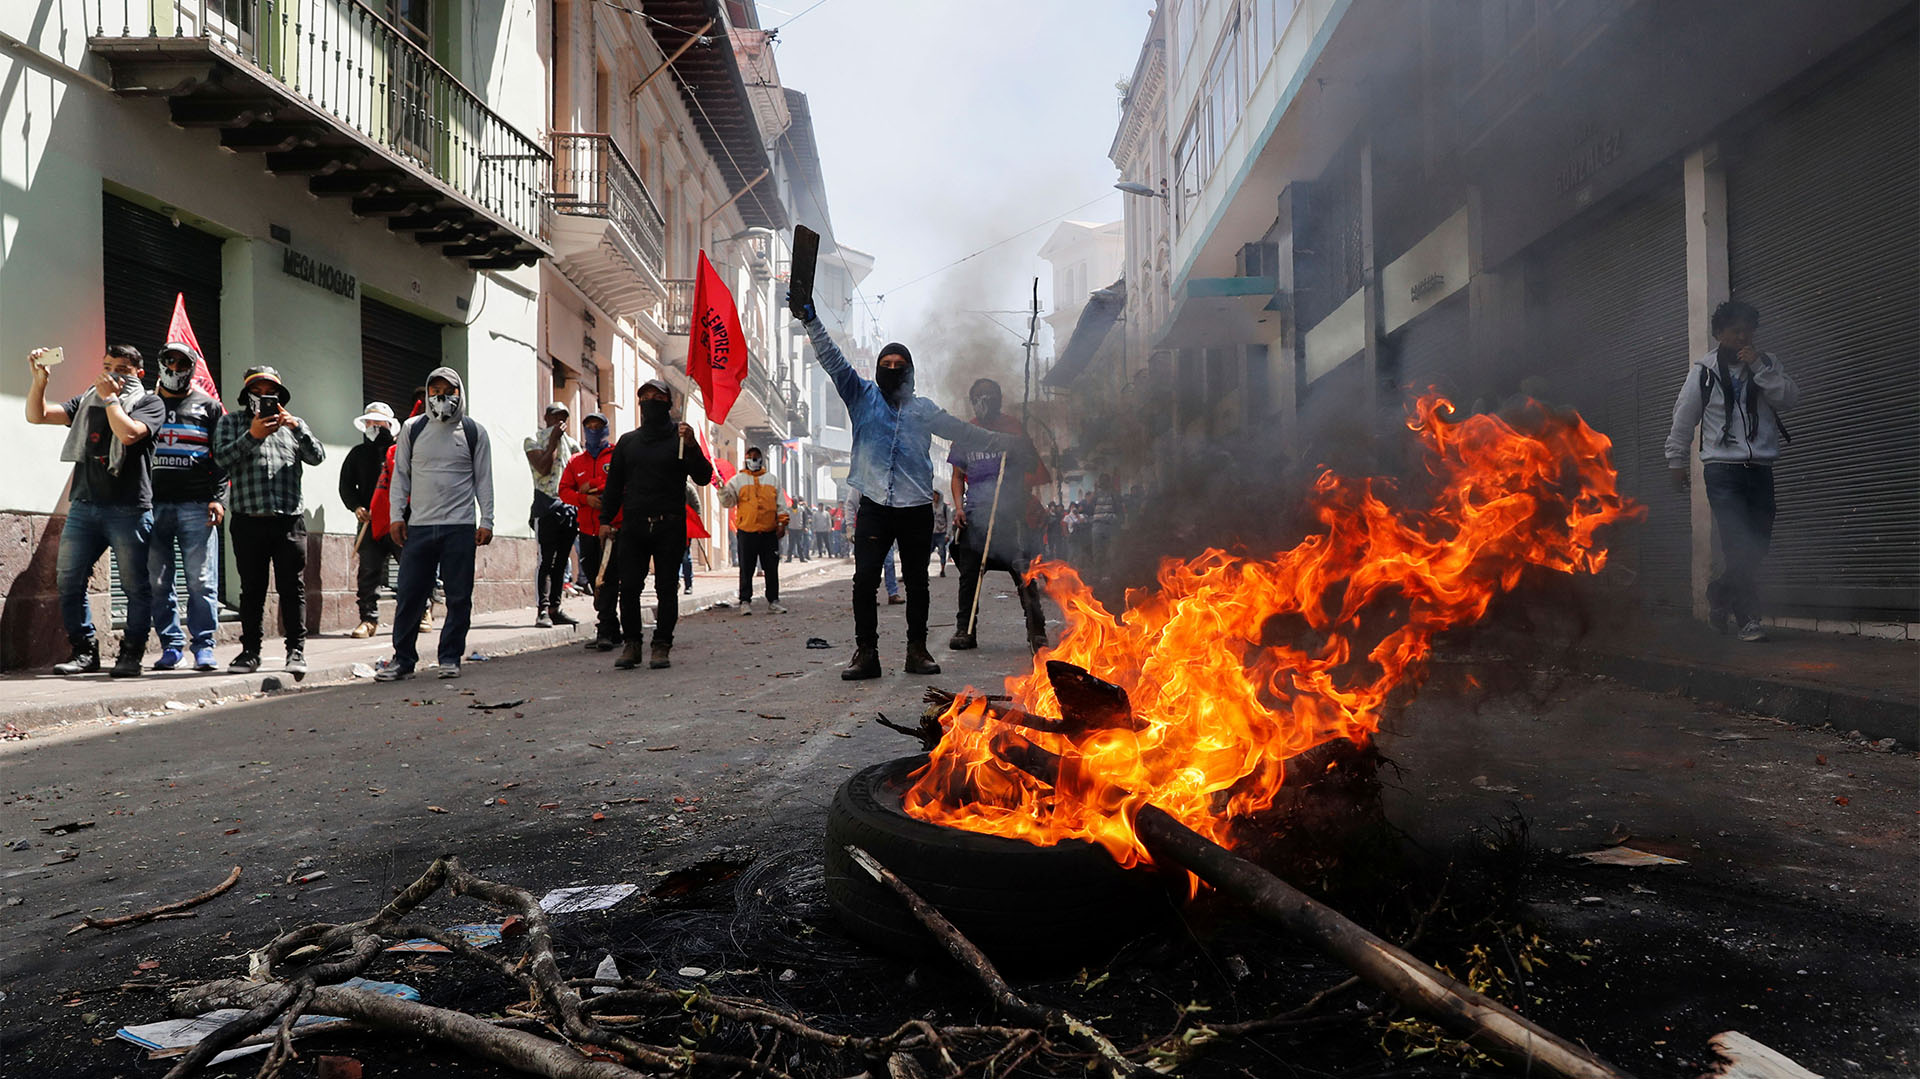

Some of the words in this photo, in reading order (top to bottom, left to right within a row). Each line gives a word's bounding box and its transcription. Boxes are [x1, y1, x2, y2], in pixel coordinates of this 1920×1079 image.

[283, 248, 316, 285] MEGA
[317, 262, 356, 300] HOGAR
[708, 315, 730, 370] EMPRESA
[168, 410, 176, 424] 3
